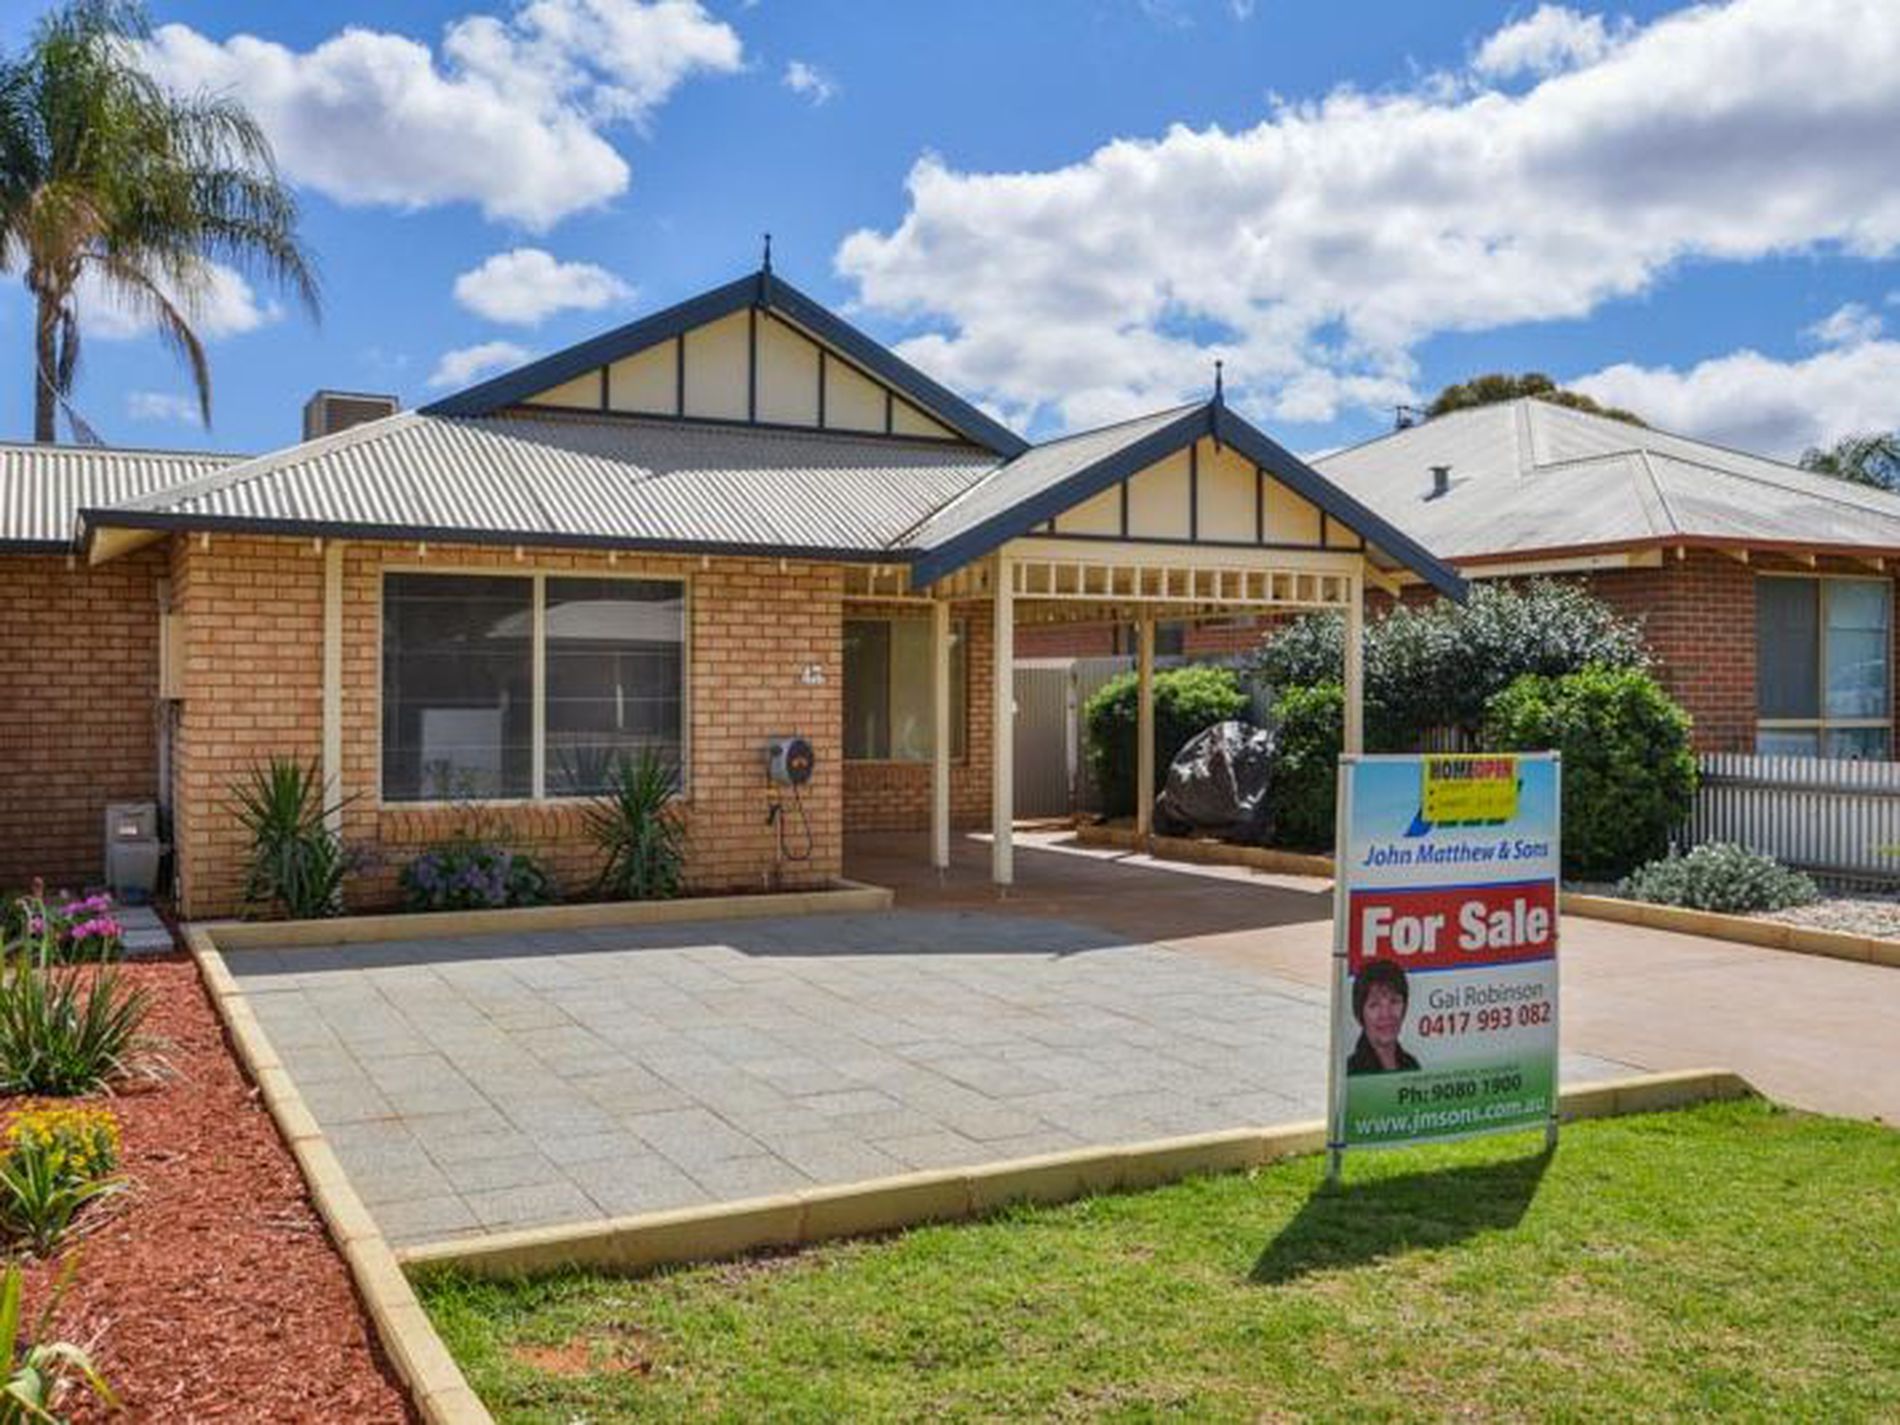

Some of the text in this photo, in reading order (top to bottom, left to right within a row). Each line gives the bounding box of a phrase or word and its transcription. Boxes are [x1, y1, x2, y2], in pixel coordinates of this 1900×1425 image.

[1362, 839, 1549, 867] John Matthew & Sons
[1361, 897, 1550, 958] For Sale
[1465, 981, 1544, 1007] Robinson
[1418, 1001, 1551, 1037] 0417 993 082
[1354, 1098, 1546, 1134] www.jmsons.com.au
